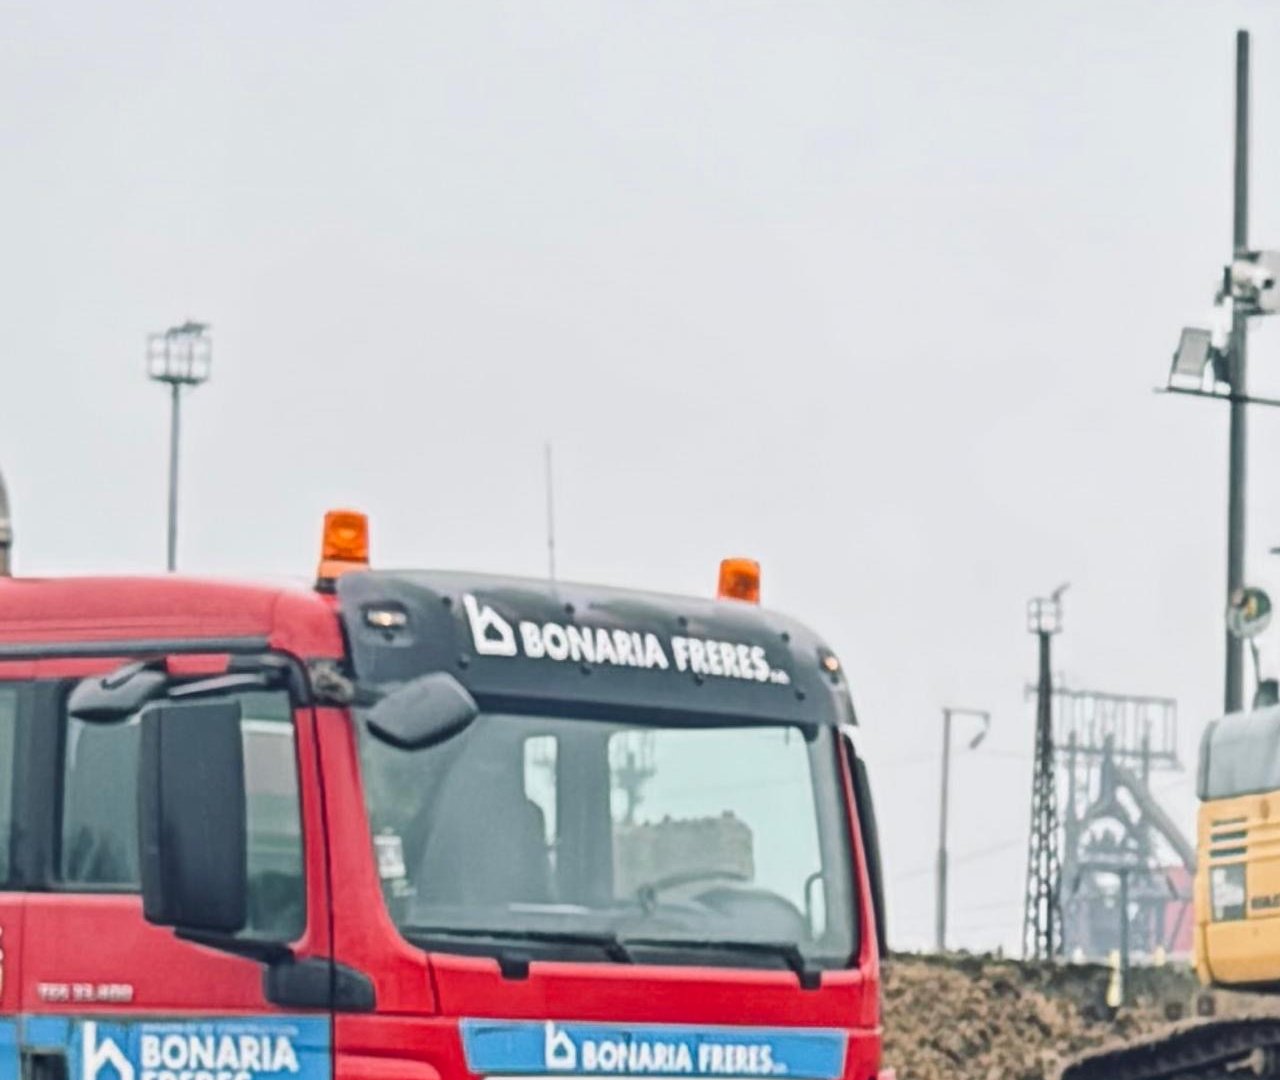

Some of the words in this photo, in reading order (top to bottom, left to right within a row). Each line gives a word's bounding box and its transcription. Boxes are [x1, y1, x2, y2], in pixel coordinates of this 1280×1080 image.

[519, 620, 669, 670] BONARIA
[671, 636, 770, 683] FRERES
[141, 1035, 299, 1073] BONARIA
[582, 1040, 693, 1073] BONARIA
[699, 1042, 774, 1074] FRERES
